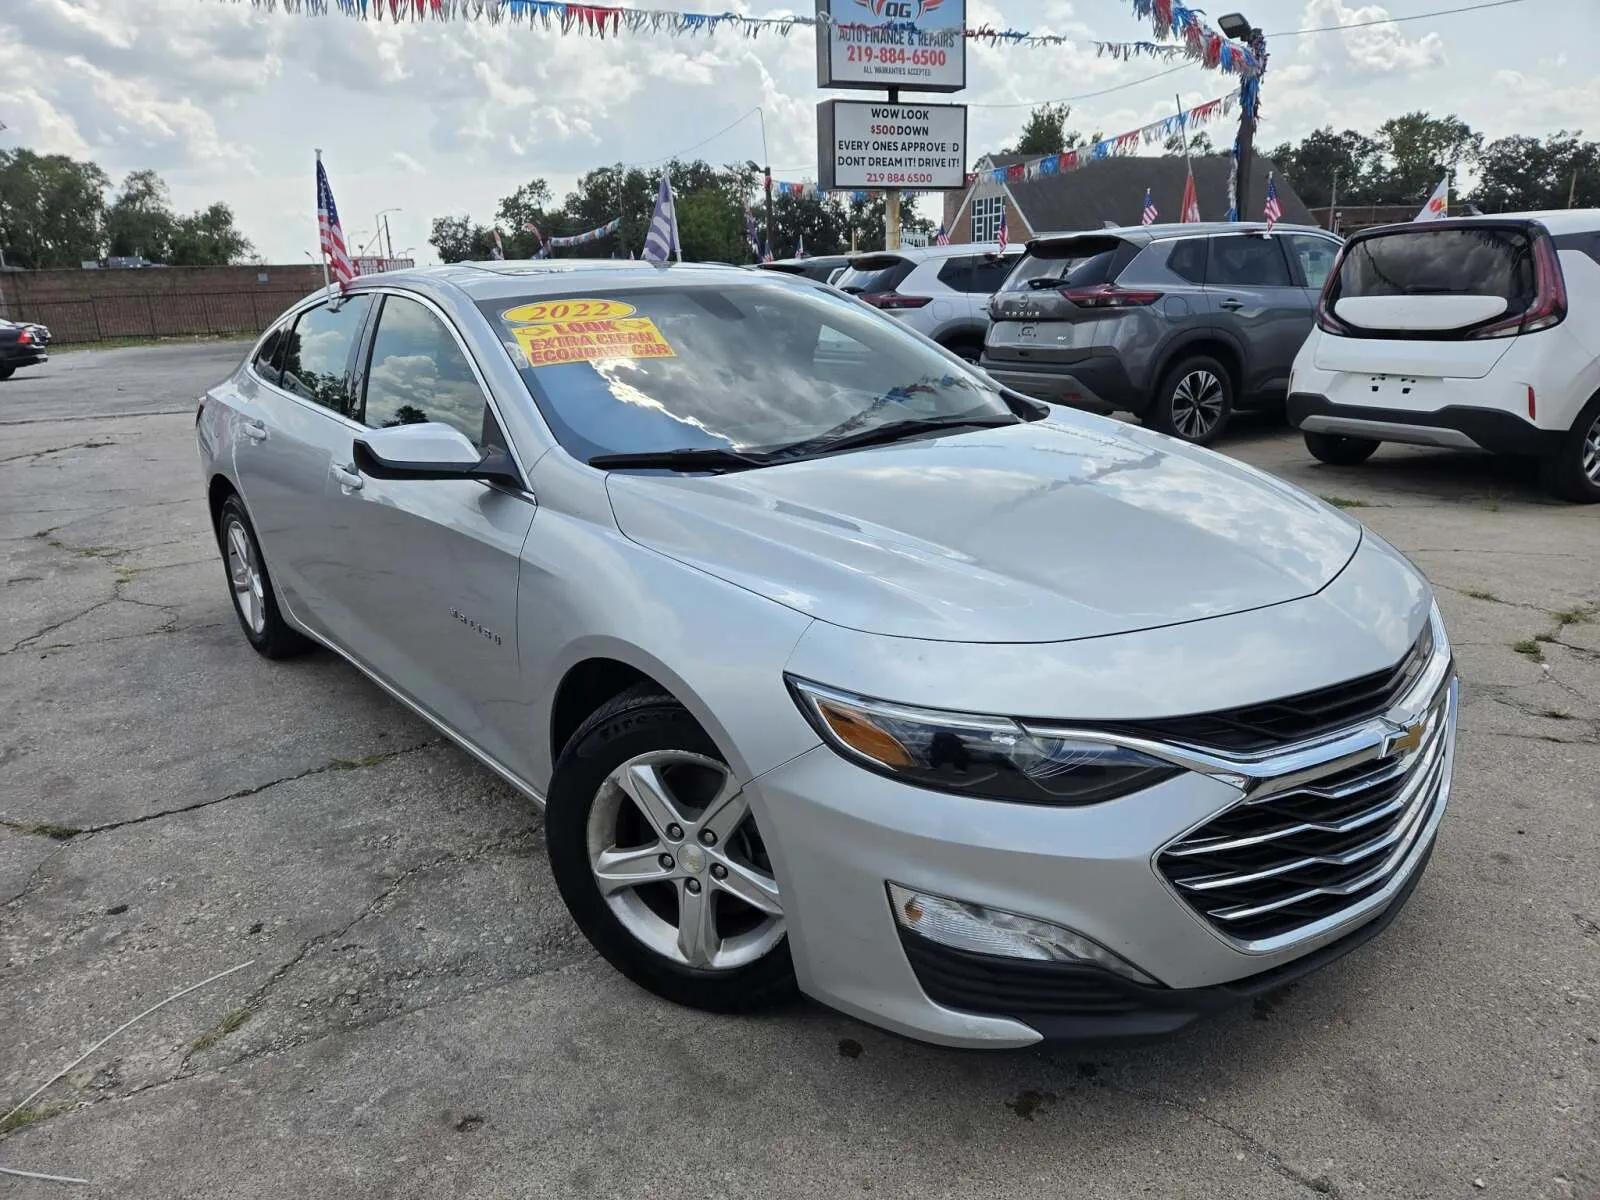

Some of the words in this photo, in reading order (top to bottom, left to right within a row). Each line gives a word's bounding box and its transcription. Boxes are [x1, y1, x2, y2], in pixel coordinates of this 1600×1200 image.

[885, 2, 912, 18] OG
[865, 29, 905, 46] FINANCE
[907, 32, 914, 46] &
[918, 31, 955, 48] REPAIRS
[847, 45, 946, 66] 219-884-6500
[863, 66, 873, 74] ALL
[874, 67, 906, 76] WARRANTIES
[871, 108, 899, 119] WOW
[901, 109, 929, 120] LOOK
[870, 125, 895, 135] $500
[897, 126, 929, 136] DOWN
[838, 140, 870, 150] EVERY
[872, 141, 898, 151] ONES
[900, 142, 946, 152] APPROVE
[838, 156, 866, 166] DONT
[868, 157, 902, 167] DREAM
[904, 157, 917, 167] IT!
[918, 157, 946, 167] DRIVE
[948, 157, 960, 168] IT!
[866, 172, 885, 182] 219
[887, 173, 905, 182] 884
[907, 173, 932, 183] 6500
[528, 302, 611, 320] 2022
[552, 320, 619, 335] LOOK
[529, 335, 593, 351] EXTRA
[596, 331, 657, 346] CLEAN
[631, 343, 673, 355] CAR
